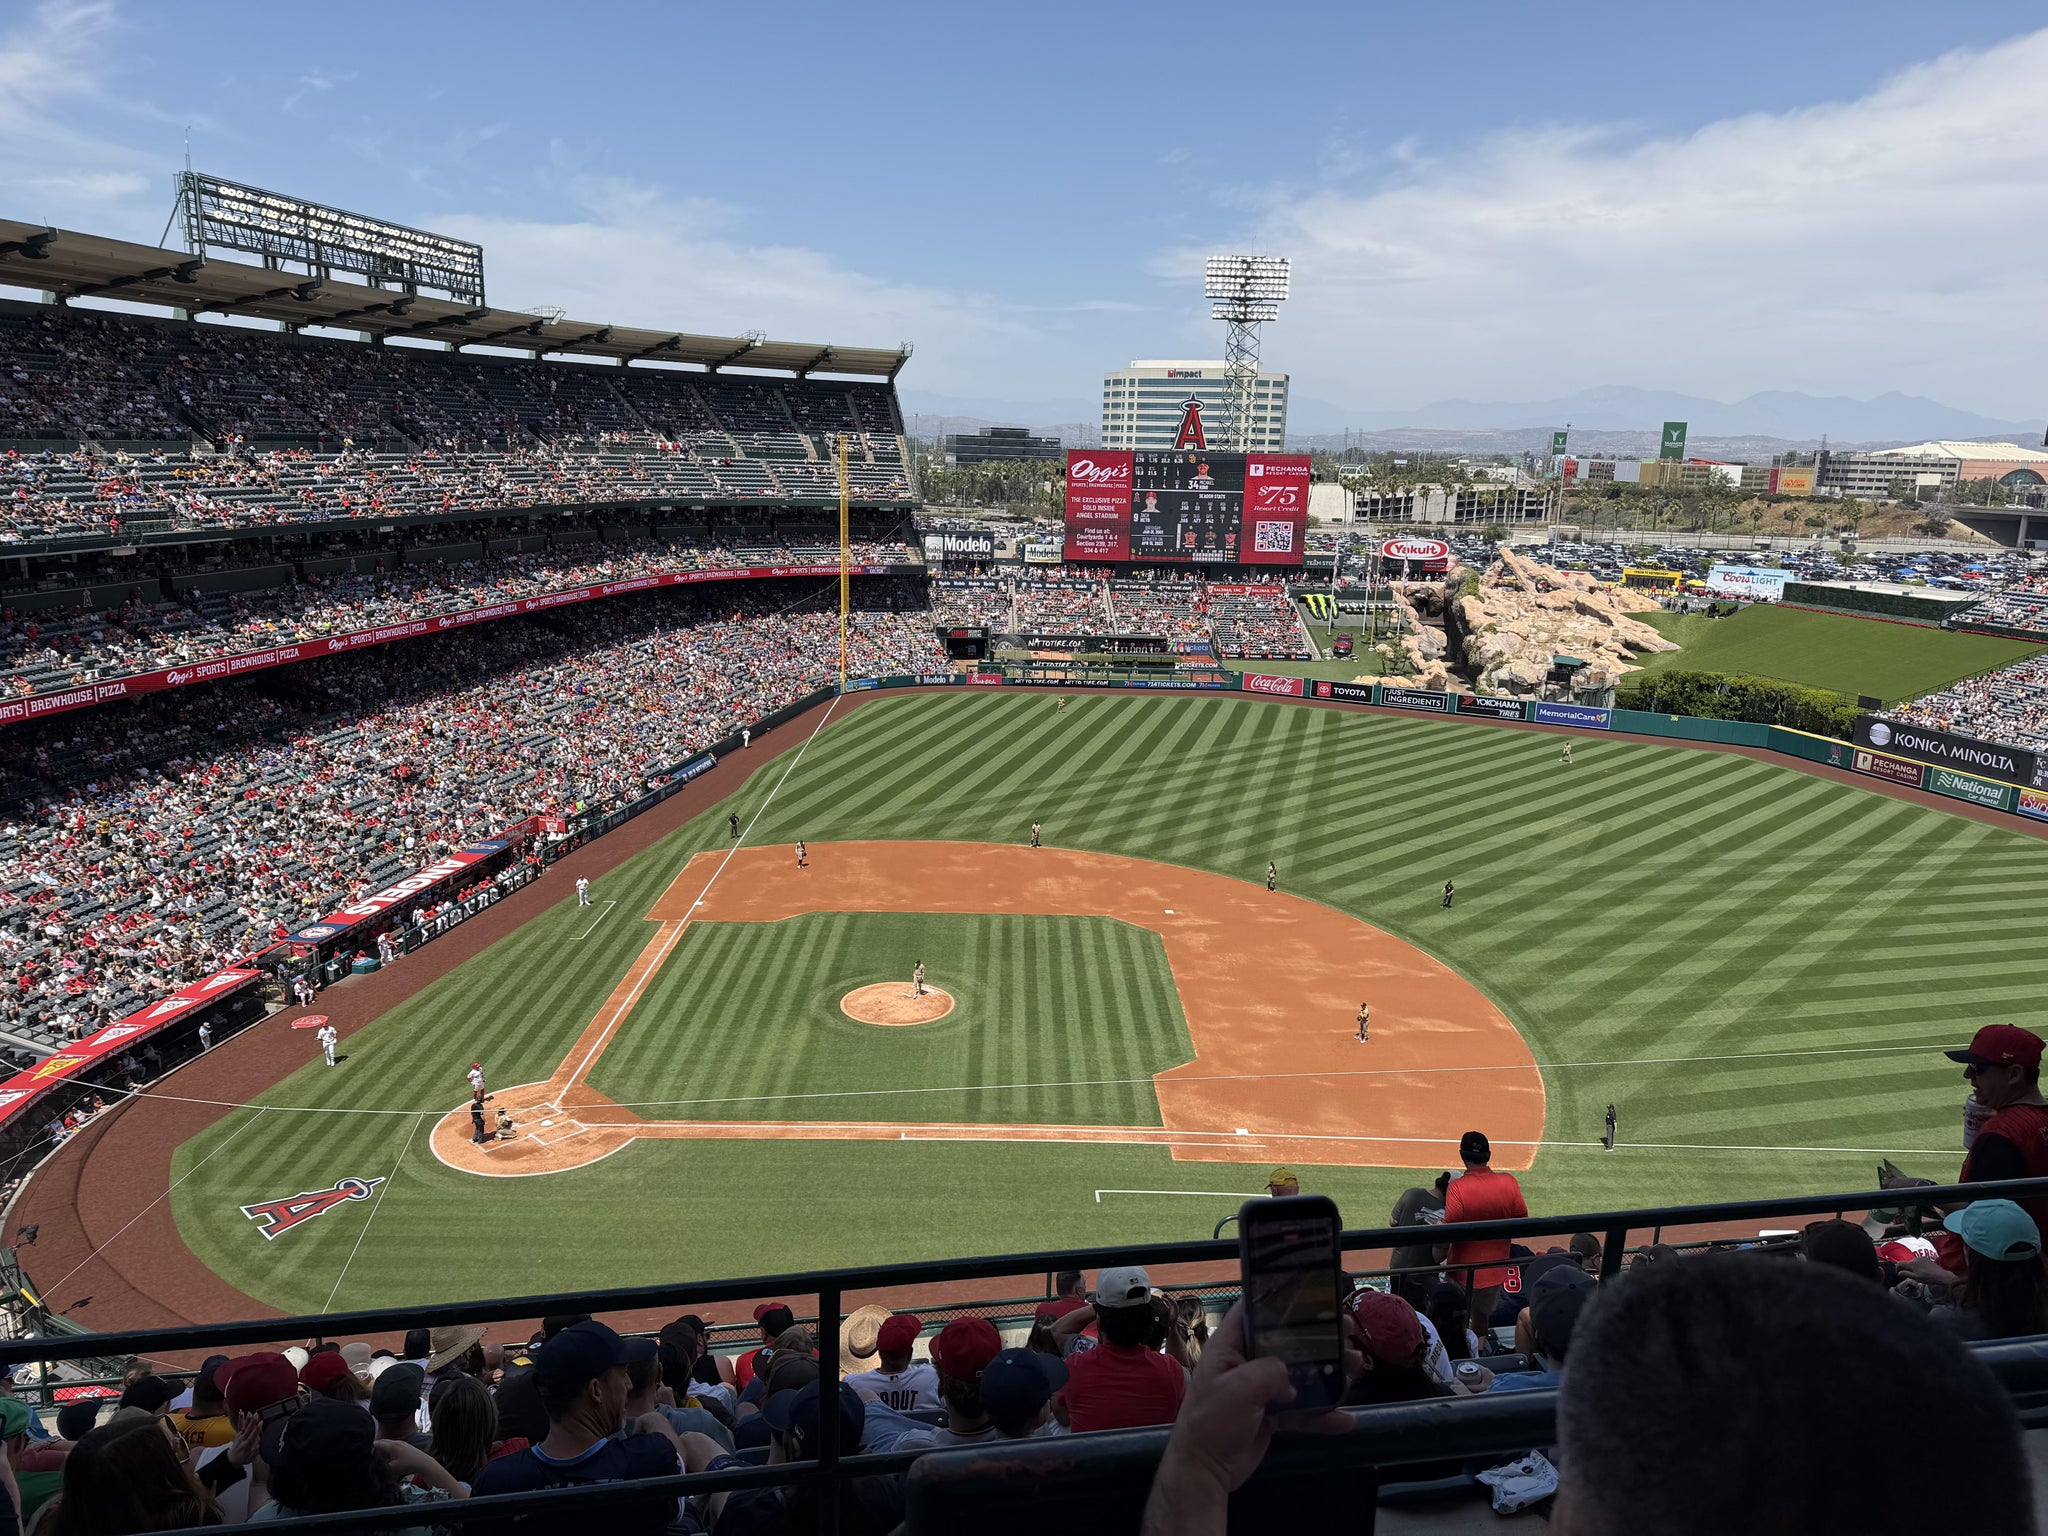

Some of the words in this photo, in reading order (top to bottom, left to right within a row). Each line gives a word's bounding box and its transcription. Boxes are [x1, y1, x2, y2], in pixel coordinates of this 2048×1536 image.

[1174, 368, 1202, 378] impact
[1071, 460, 1130, 482] Oggi's
[1188, 480, 1199, 490] 34
[1258, 486, 1299, 504] $75
[1134, 514, 1138, 522] 9
[944, 535, 991, 552] Modelo
[1394, 545, 1438, 554] Yakult
[1027, 547, 1058, 558] Modelo
[674, 574, 688, 582] Oggi's
[689, 572, 704, 580] SPORTS
[706, 570, 734, 578] BREWHOUSE
[1722, 572, 1751, 584] Coors
[1751, 578, 1778, 586] LIGHT
[439, 617, 455, 628] Oggi's
[456, 613, 474, 623] SPORTS
[476, 606, 503, 620] BREWHOUSE
[505, 604, 517, 613] PIZZA
[328, 638, 348, 650] Oggi's
[350, 633, 372, 645] SPORTS
[375, 626, 409, 640] BREWHOUSE
[412, 622, 426, 632] PIZZA
[167, 669, 193, 684] Oggi's
[197, 662, 226, 677] SPORTS
[231, 652, 275, 670] BREWHOUSE
[279, 648, 299, 660] PIZZA
[924, 676, 946, 684] Modelo
[1250, 676, 1294, 693] Coca-Cola
[30, 690, 93, 712] BREWHOUSE
[100, 683, 126, 698] PIZZA
[1334, 688, 1366, 697] TOYOTA
[1388, 695, 1441, 707] INGREDIENTS
[1476, 698, 1520, 710] YOKOHAMA
[1499, 710, 1520, 718] TIRES
[1540, 710, 1596, 722] MemorialCare
[1894, 732, 1947, 756] KONICA
[1950, 746, 2014, 772] MINOLTA
[1872, 766, 1894, 775] RESORT
[1896, 770, 1918, 780] CASINO
[1874, 758, 1918, 776] PECHANGA
[1952, 777, 2004, 799] National
[1980, 796, 1999, 805] Rental
[344, 858, 467, 915] ANGELS
